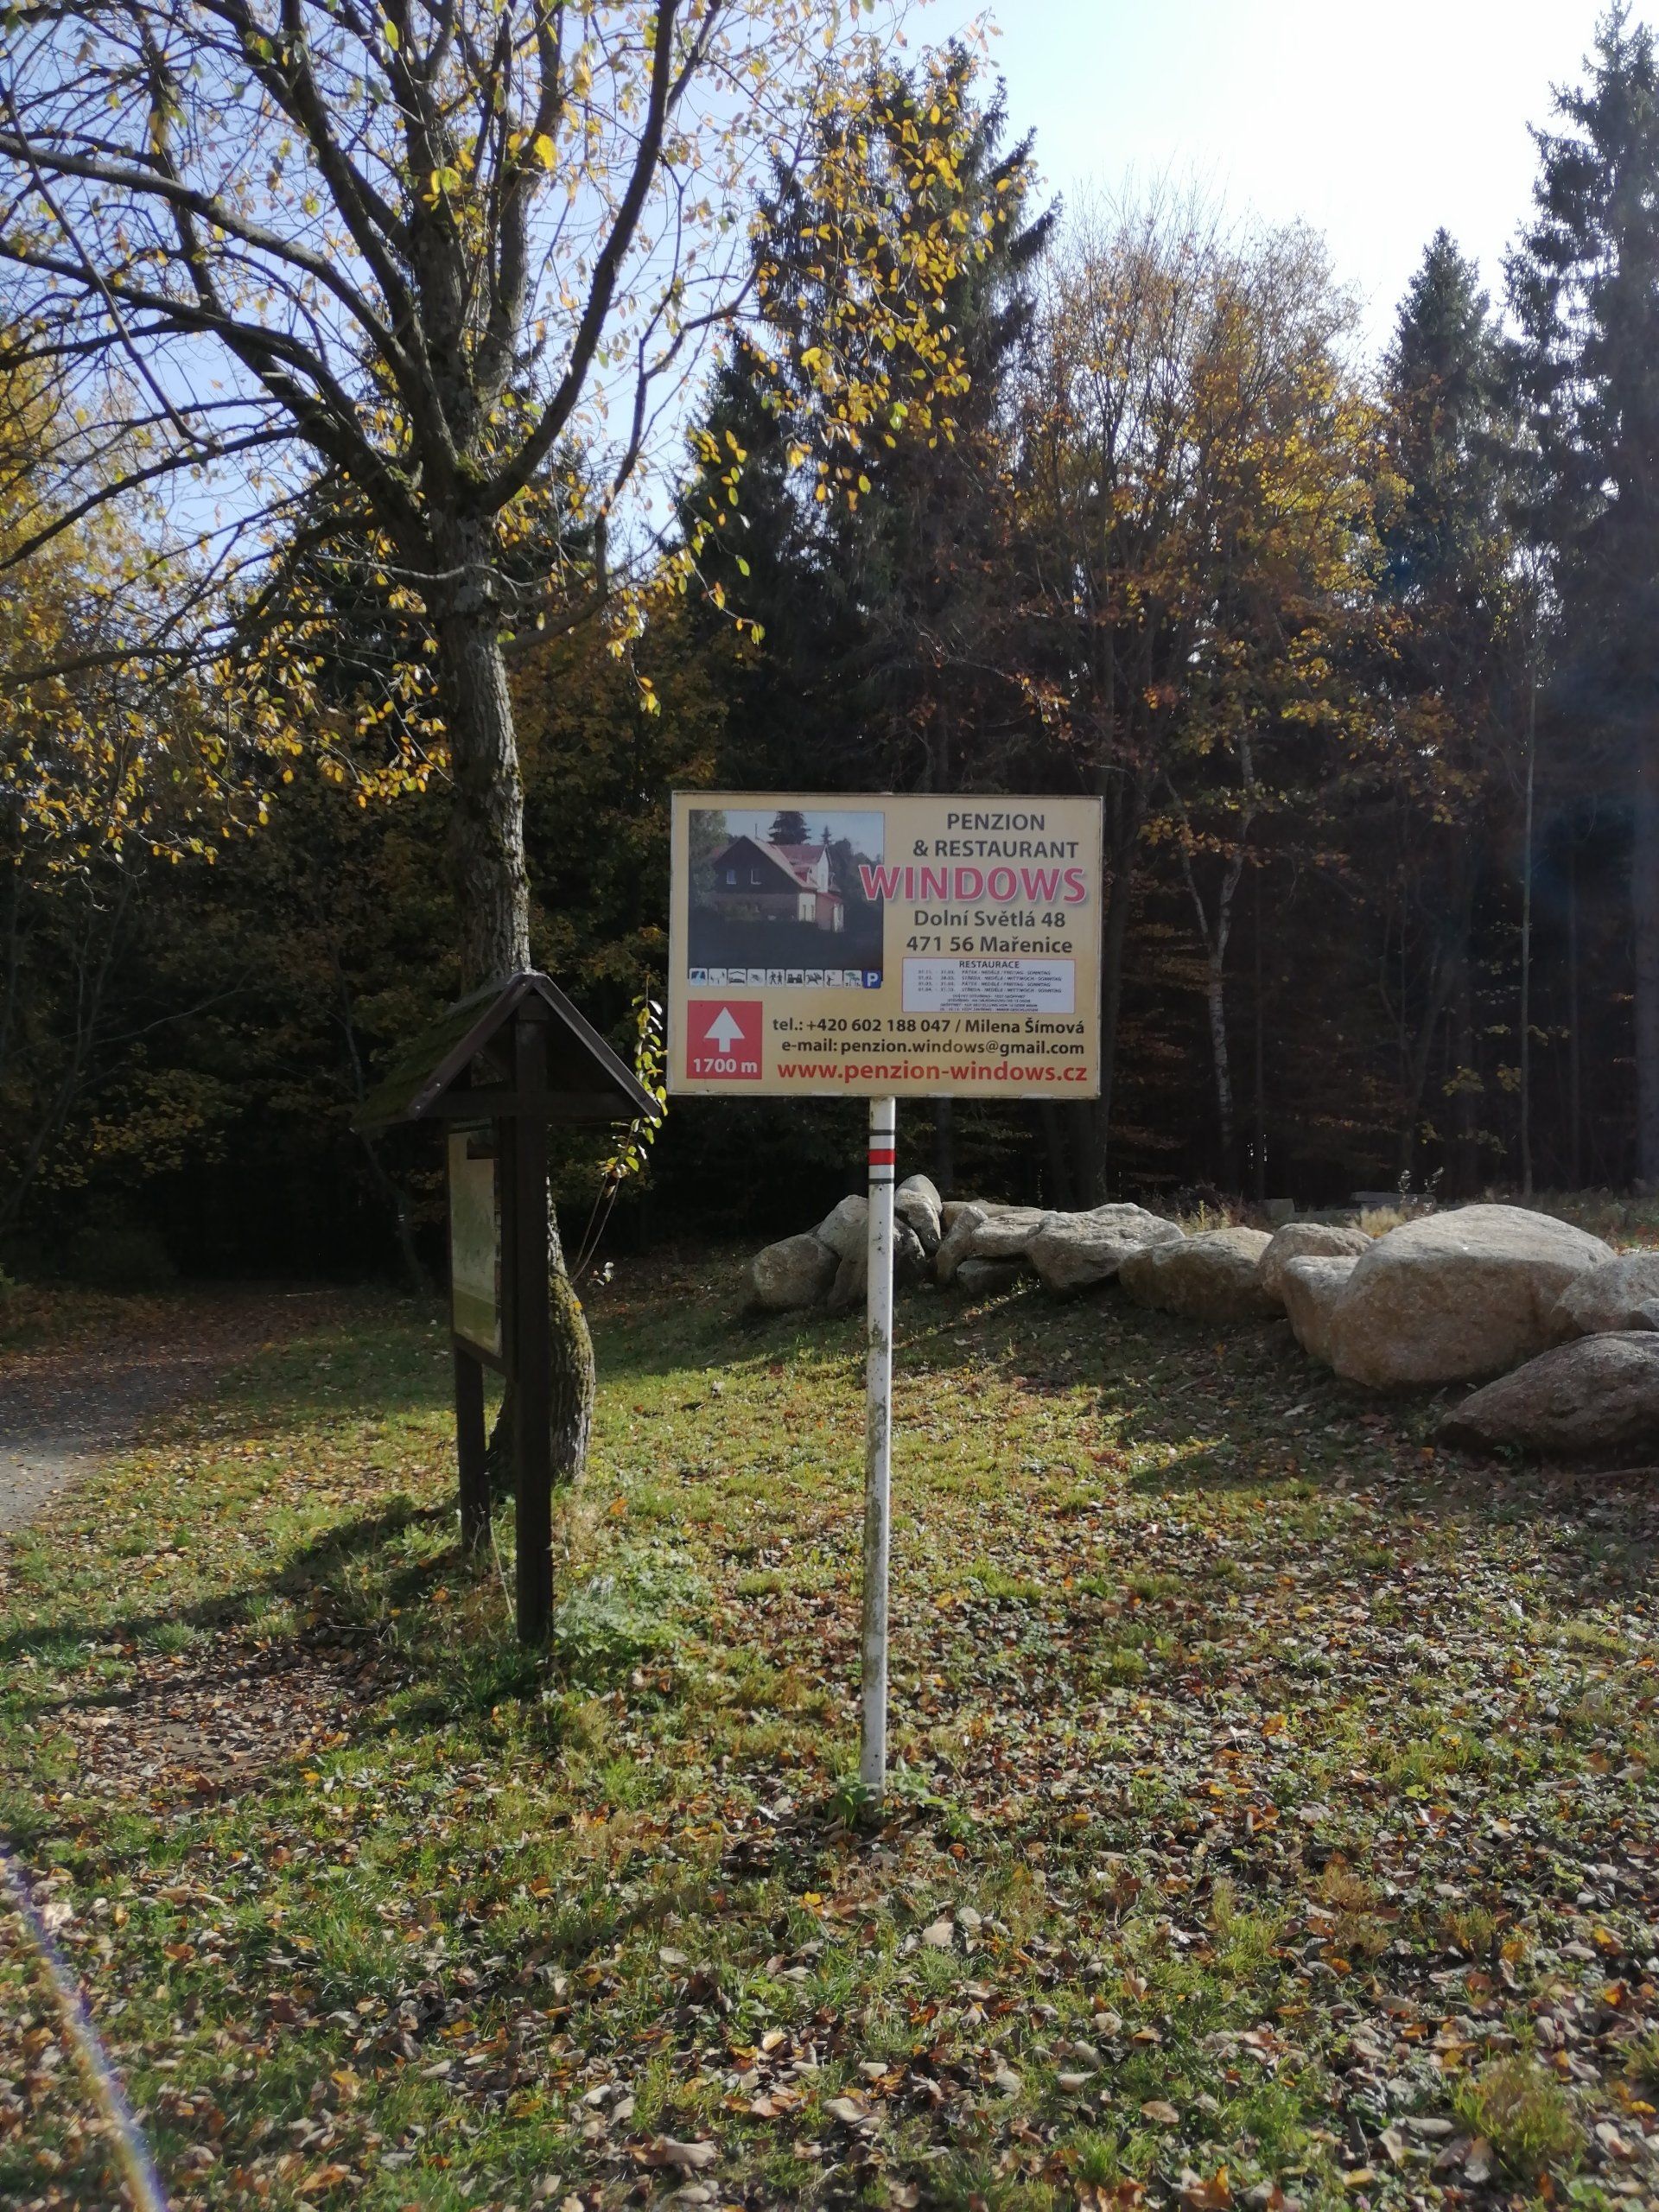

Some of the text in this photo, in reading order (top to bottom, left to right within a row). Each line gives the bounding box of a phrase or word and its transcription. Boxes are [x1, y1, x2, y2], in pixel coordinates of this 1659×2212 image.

[947, 813, 1046, 831] PENZION
[913, 839, 1079, 859] & RESTAURANT
[860, 865, 1086, 903] WINDOWS
[914, 908, 1066, 928] Dolní Světlá 48
[906, 935, 1073, 954] 471 56 Mařenice
[959, 960, 1020, 969] RESTAURACE
[772, 1015, 1084, 1034] tel.: +420 602 188 047 / Milena Šímová
[781, 1038, 1084, 1057] e-mail: penzion.windows@gmail.com
[693, 1058, 758, 1073] 1700 m
[777, 1061, 1087, 1082] www.penzion-windows.cz
